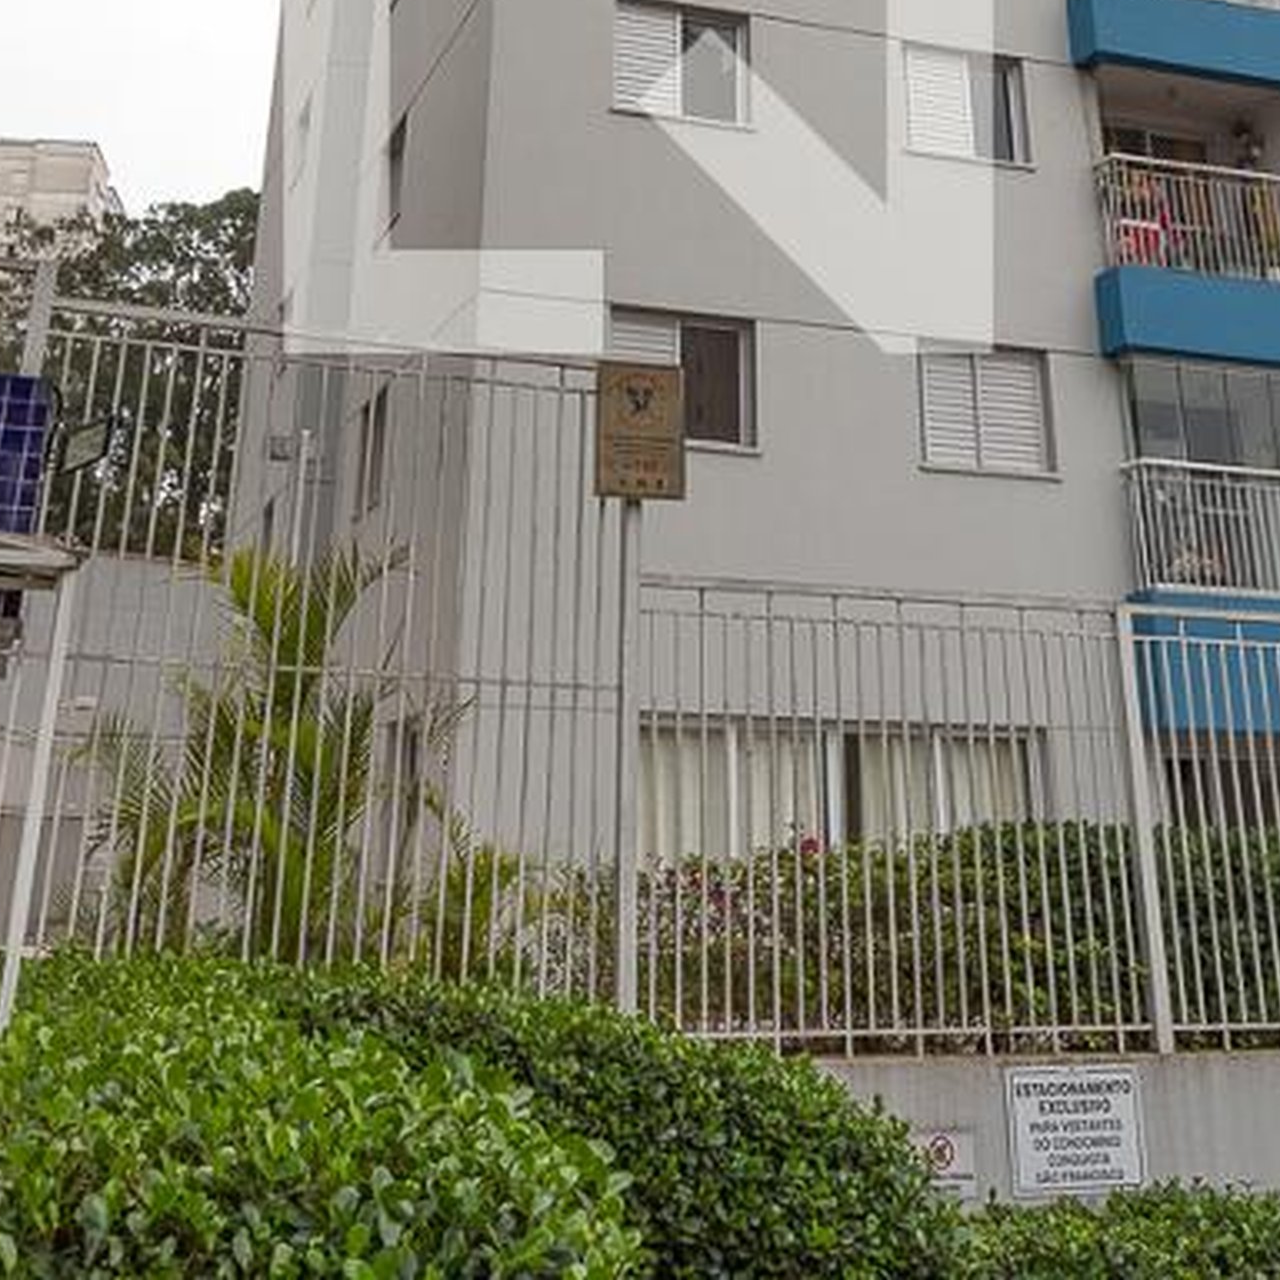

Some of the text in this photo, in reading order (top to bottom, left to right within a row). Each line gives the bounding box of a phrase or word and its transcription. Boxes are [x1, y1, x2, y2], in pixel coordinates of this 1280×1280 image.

[1016, 1080, 1131, 1097] ESTACIONAMENTO
[1038, 1098, 1112, 1115] EXCLUSIVO
[1029, 1119, 1059, 1134] PARA
